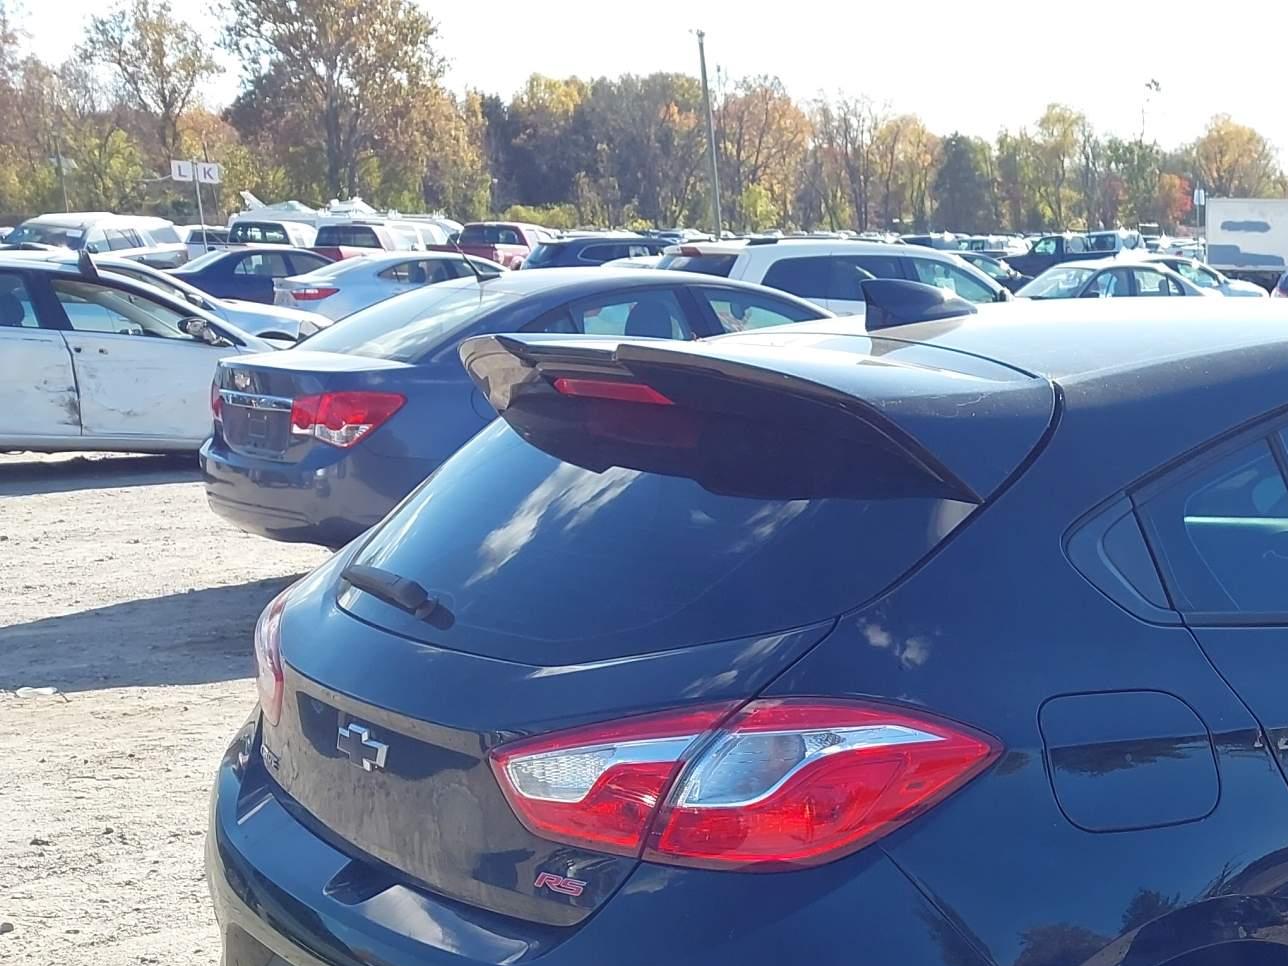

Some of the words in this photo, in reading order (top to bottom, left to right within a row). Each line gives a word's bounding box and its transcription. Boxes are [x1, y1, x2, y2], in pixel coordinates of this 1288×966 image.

[178, 164, 187, 178] L
[203, 166, 214, 180] K
[534, 871, 588, 897] RS
